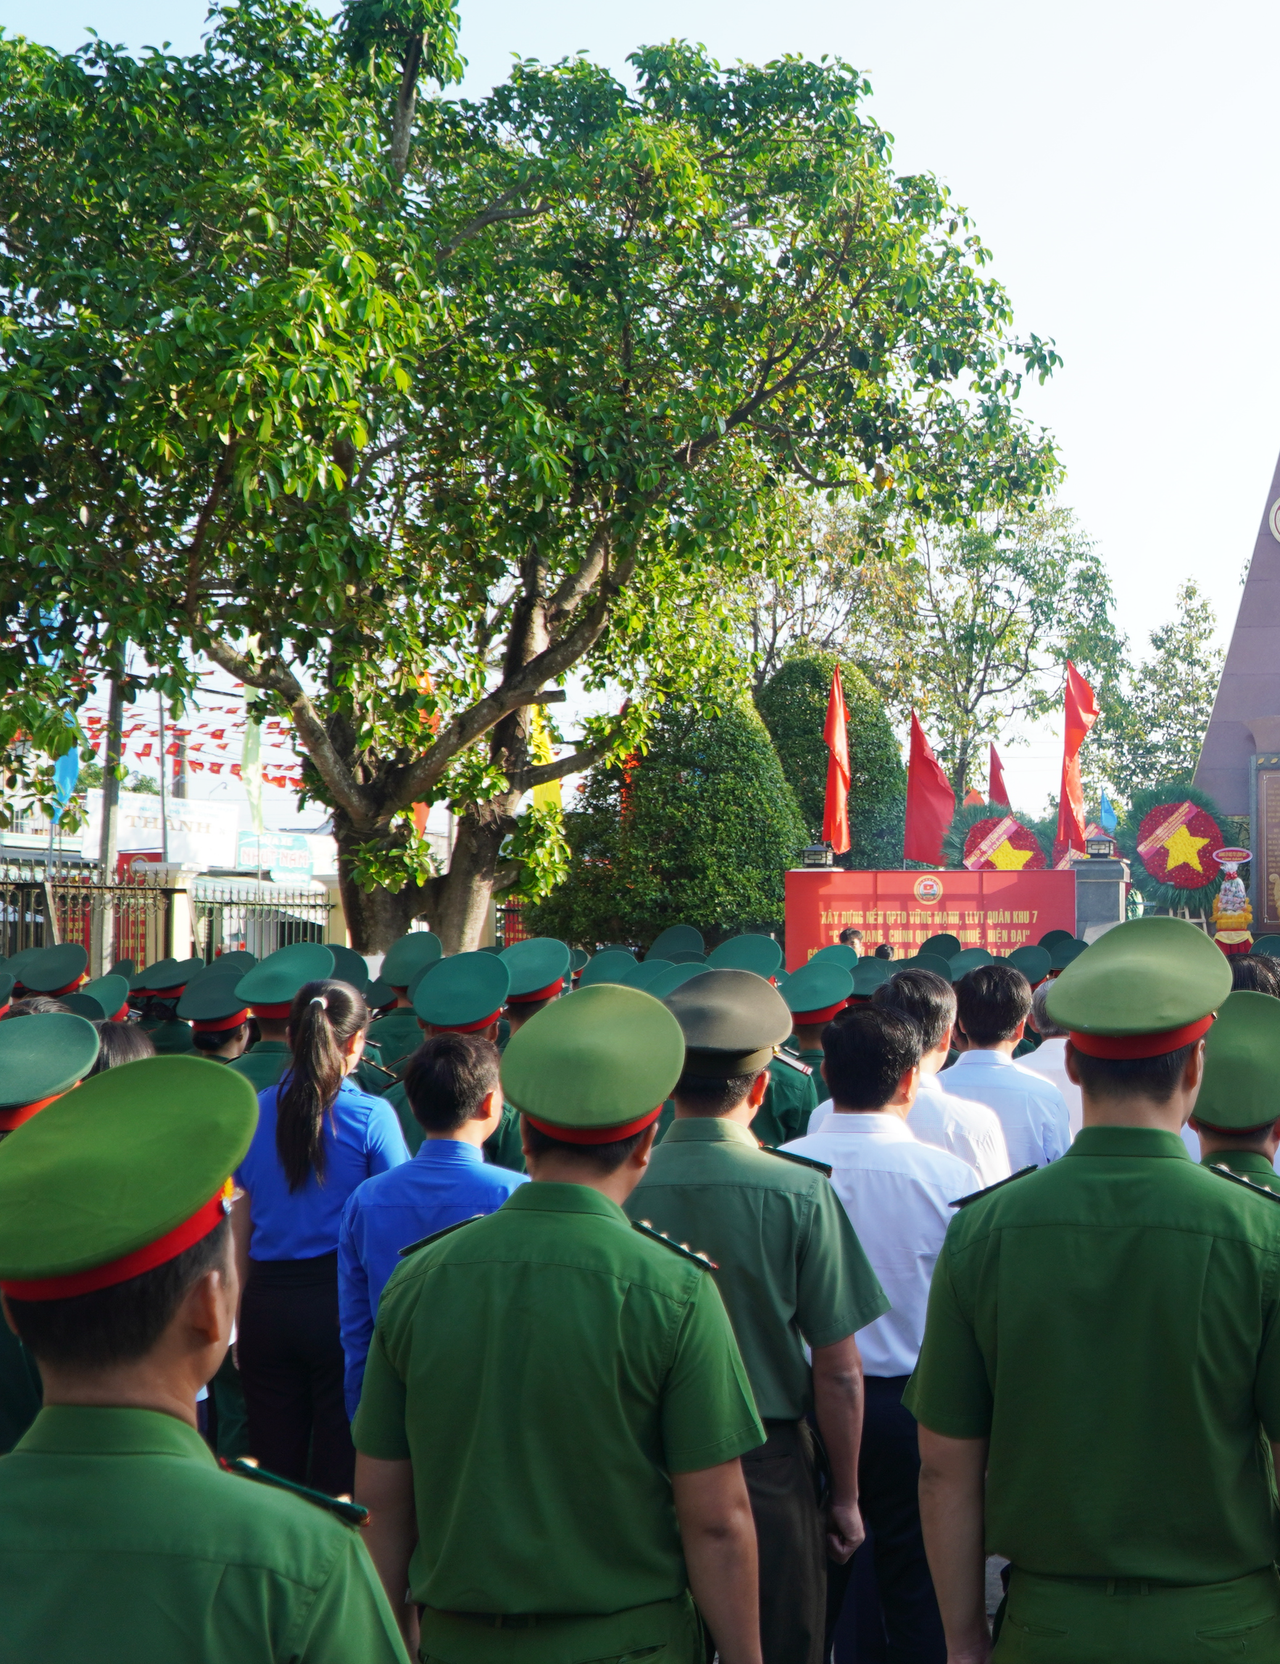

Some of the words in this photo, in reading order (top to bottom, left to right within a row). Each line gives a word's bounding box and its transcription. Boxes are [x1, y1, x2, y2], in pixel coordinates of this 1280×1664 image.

[279, 850, 309, 868] NAM
[821, 909, 839, 924] XÂY
[841, 910, 863, 926] DỰNG
[886, 911, 906, 926] QPTD
[909, 909, 931, 924] VỮNG
[934, 911, 962, 927] MẠNH,
[965, 911, 985, 924] LLVT
[987, 909, 1010, 926] QUÂN
[1013, 911, 1029, 924] KHU
[1032, 911, 1038, 924] 7
[888, 928, 913, 943] CHÍNH
[960, 928, 985, 945] NHUỆ,
[988, 928, 1008, 945] HIỆN
